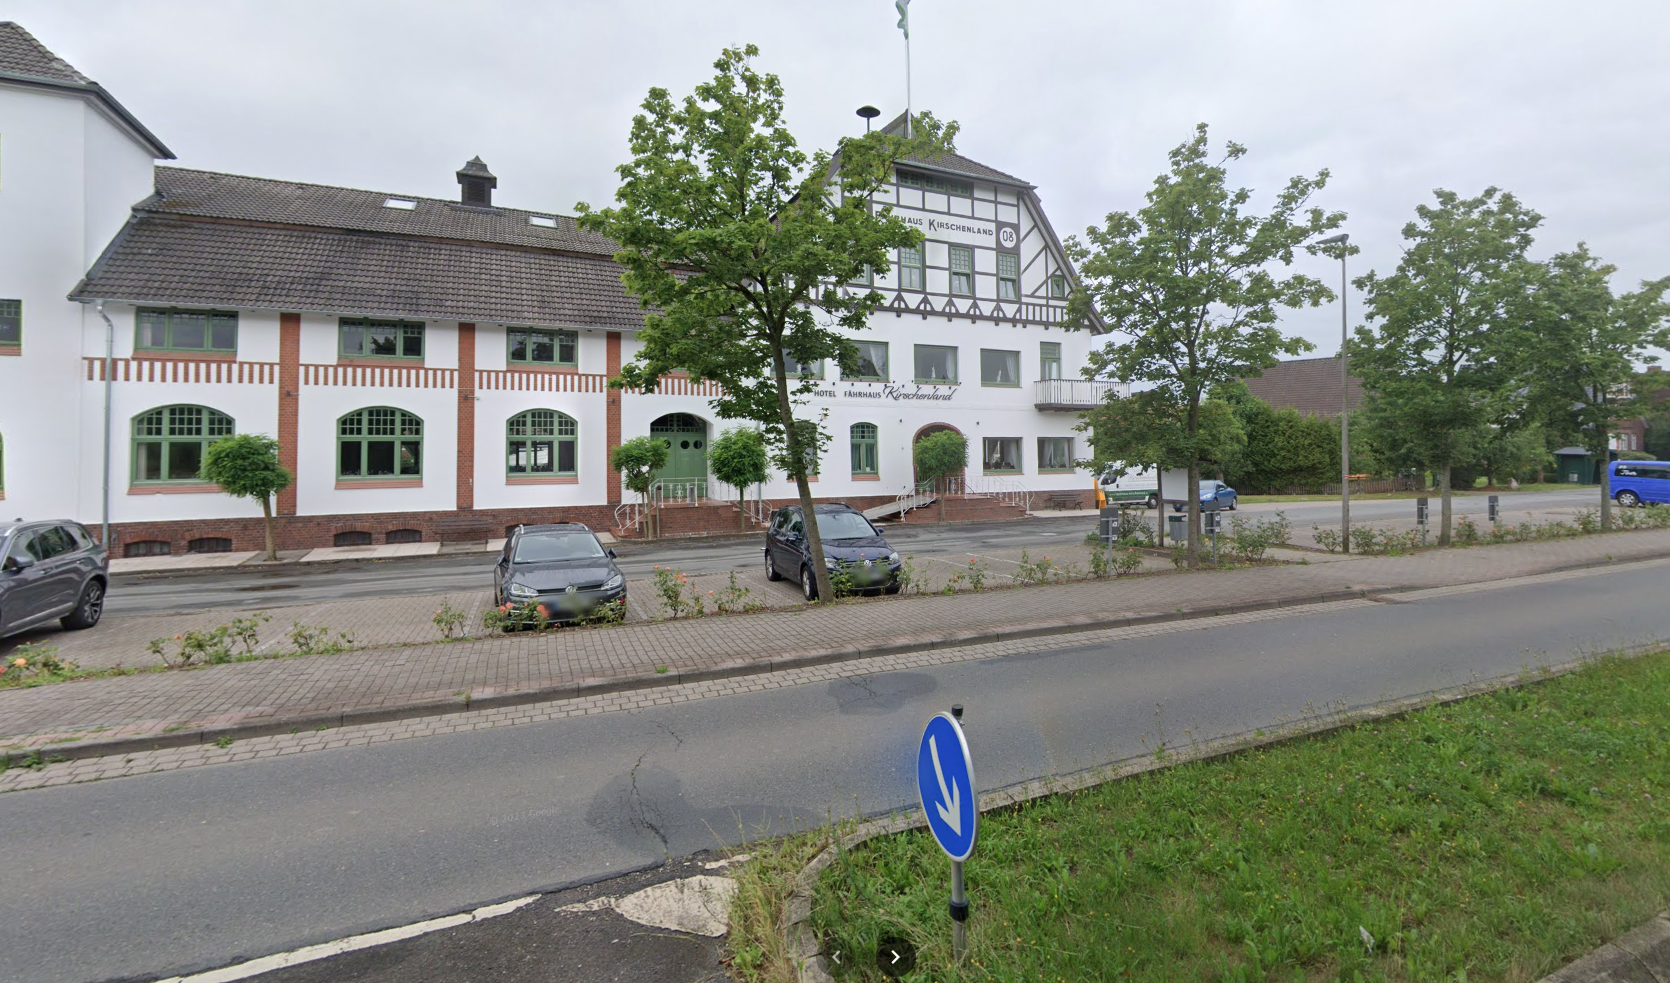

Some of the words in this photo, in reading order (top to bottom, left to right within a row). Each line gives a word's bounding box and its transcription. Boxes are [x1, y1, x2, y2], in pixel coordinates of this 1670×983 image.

[1002, 230, 1014, 243] 08
[814, 389, 836, 398] HOTEL
[844, 389, 882, 399] FÄHRHAUS
[883, 385, 957, 401] Kirschenland
